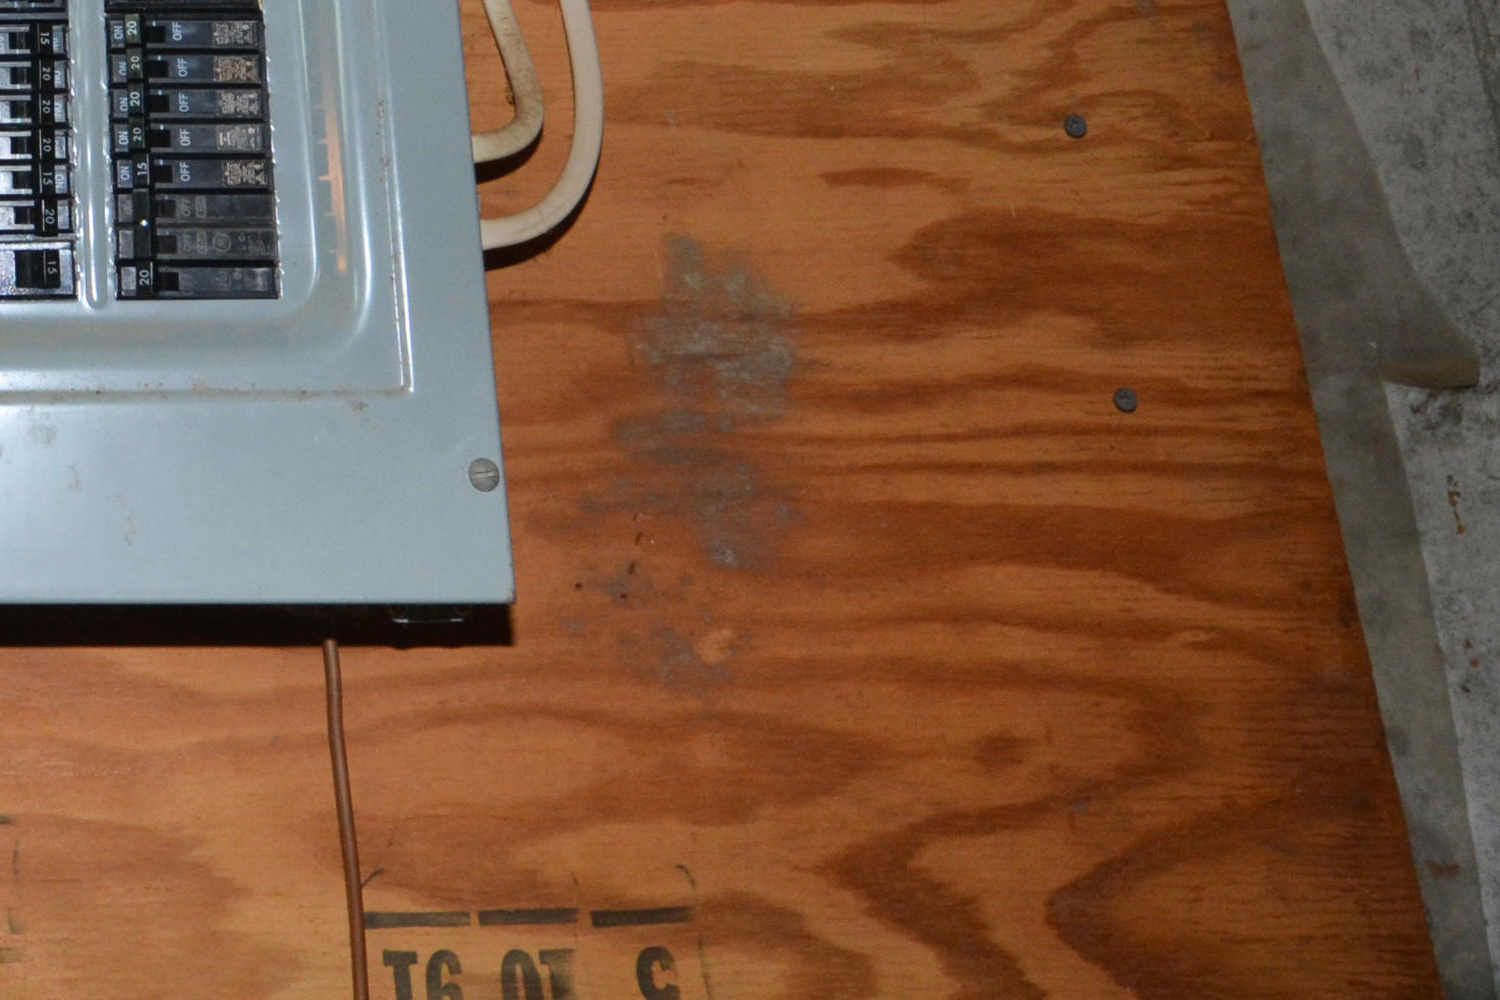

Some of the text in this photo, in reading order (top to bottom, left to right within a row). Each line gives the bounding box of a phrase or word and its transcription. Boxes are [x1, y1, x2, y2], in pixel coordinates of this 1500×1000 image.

[115, 25, 123, 40] ON
[127, 21, 136, 35] 20
[173, 22, 182, 41] OFF
[40, 32, 50, 45] 15
[131, 56, 139, 70] 20
[178, 58, 188, 77] OFF
[43, 68, 50, 81] 20
[130, 92, 140, 107] 20
[179, 93, 188, 113] OFF
[42, 100, 50, 114] 20
[119, 131, 128, 145] ON
[133, 127, 142, 141] 20
[180, 128, 190, 146] OFF
[43, 138, 51, 152] 20
[121, 166, 130, 181] ON
[137, 162, 147, 176] 15
[181, 161, 190, 182] OFF
[43, 173, 52, 186] 15
[45, 210, 54, 225] 20
[47, 261, 57, 274] 15
[139, 270, 149, 285] 20
